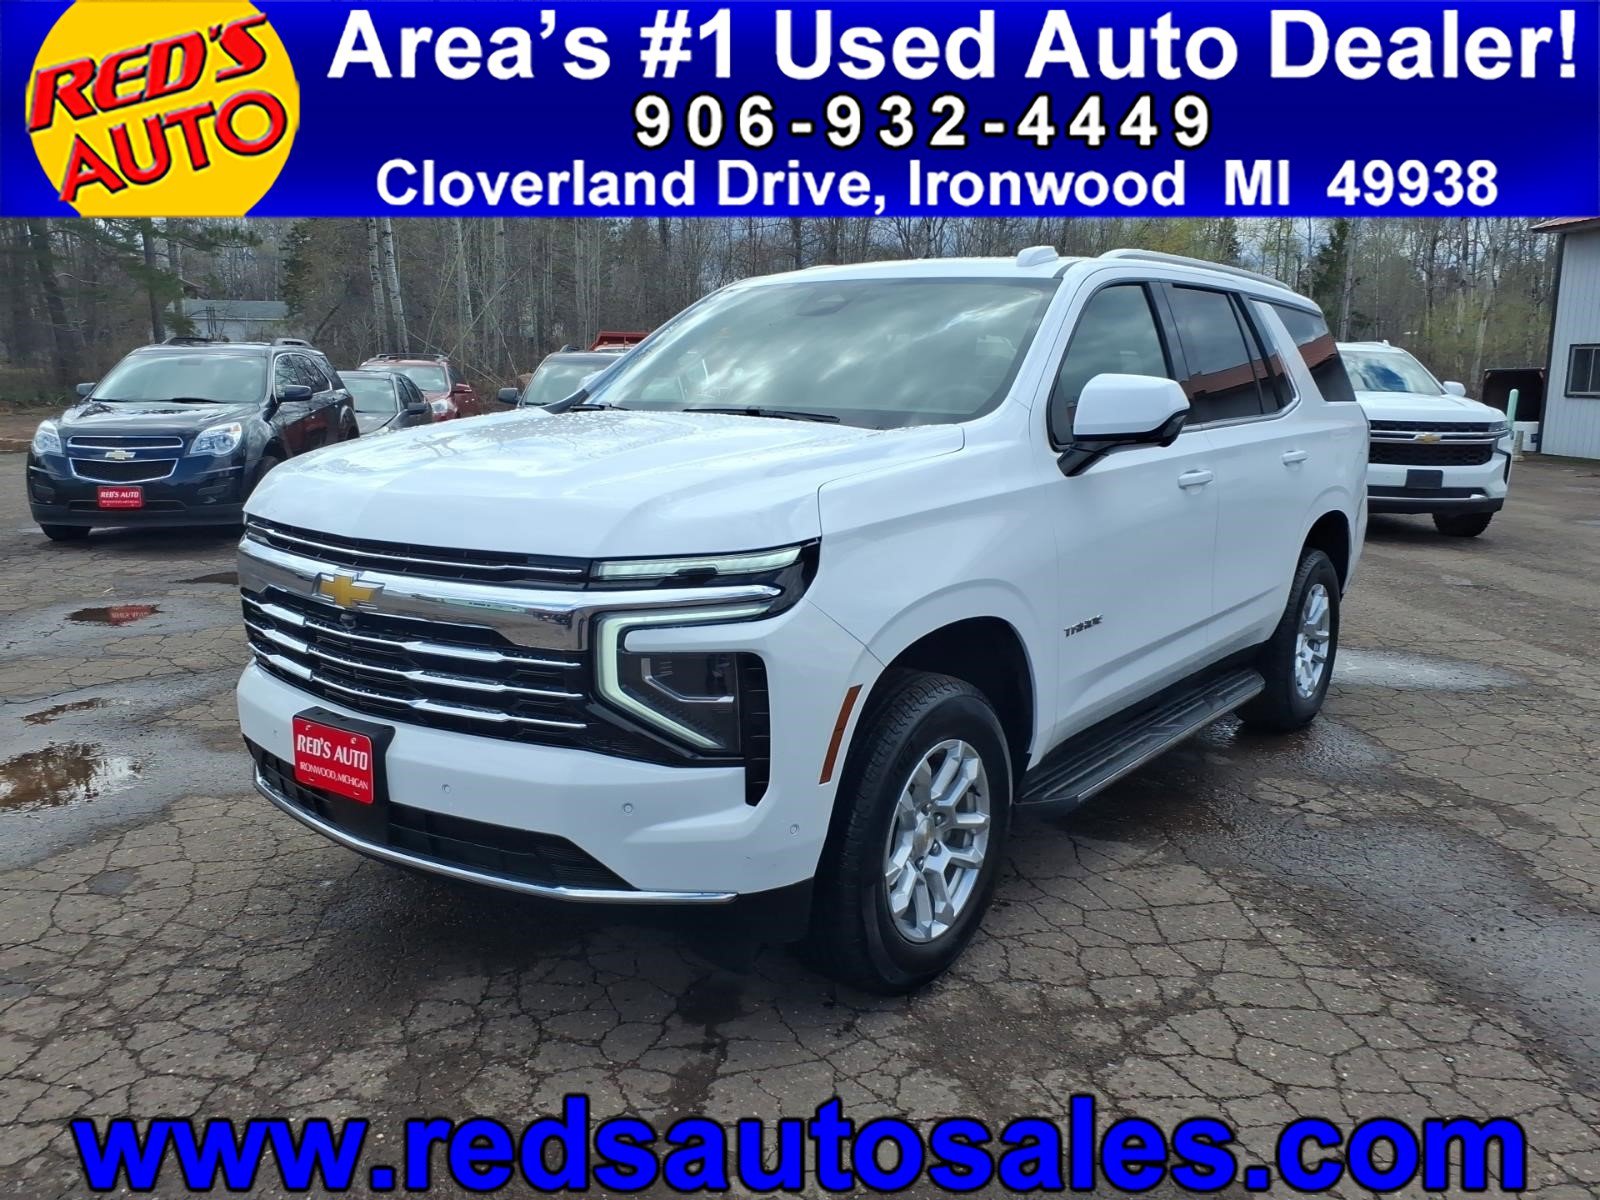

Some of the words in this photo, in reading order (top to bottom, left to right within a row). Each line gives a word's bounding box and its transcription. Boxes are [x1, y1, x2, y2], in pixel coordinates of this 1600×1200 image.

[297, 734, 332, 759] RED'S
[333, 745, 368, 771] AUTO
[337, 772, 369, 790] MICHIGAN
